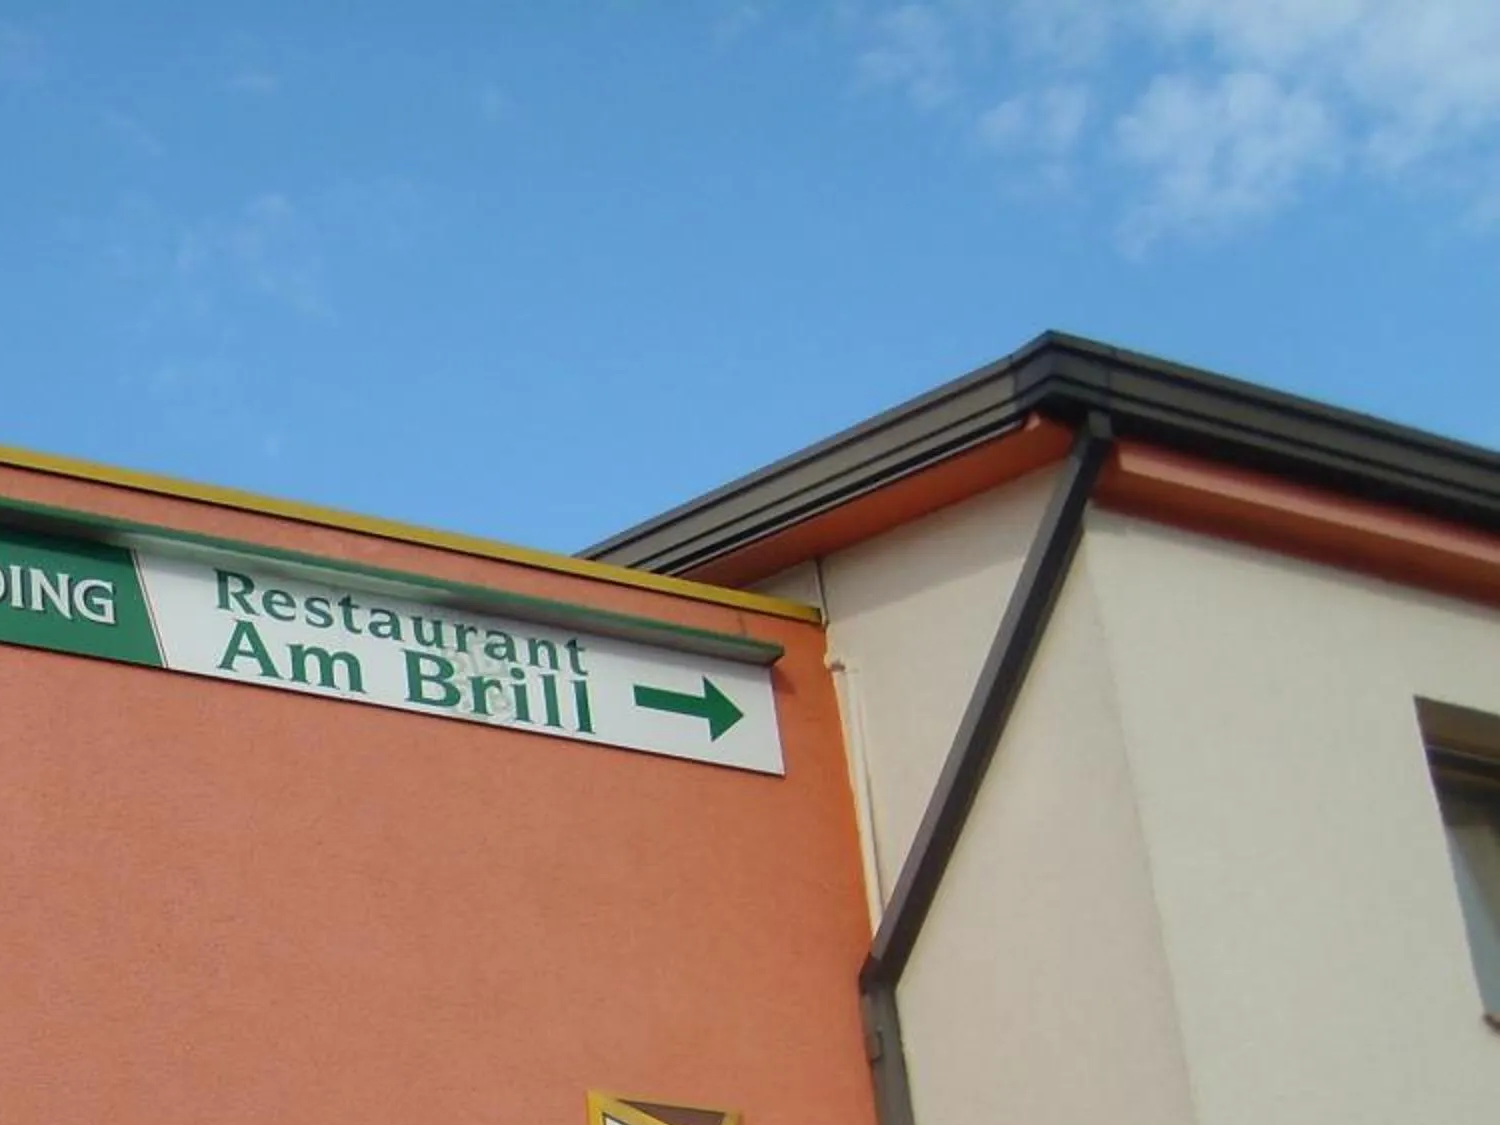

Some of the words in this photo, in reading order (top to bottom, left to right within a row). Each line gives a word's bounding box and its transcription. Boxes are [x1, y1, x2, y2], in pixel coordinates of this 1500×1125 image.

[213, 567, 589, 677] Restaurant
[216, 619, 367, 695] Am
[400, 647, 597, 734] Brill
